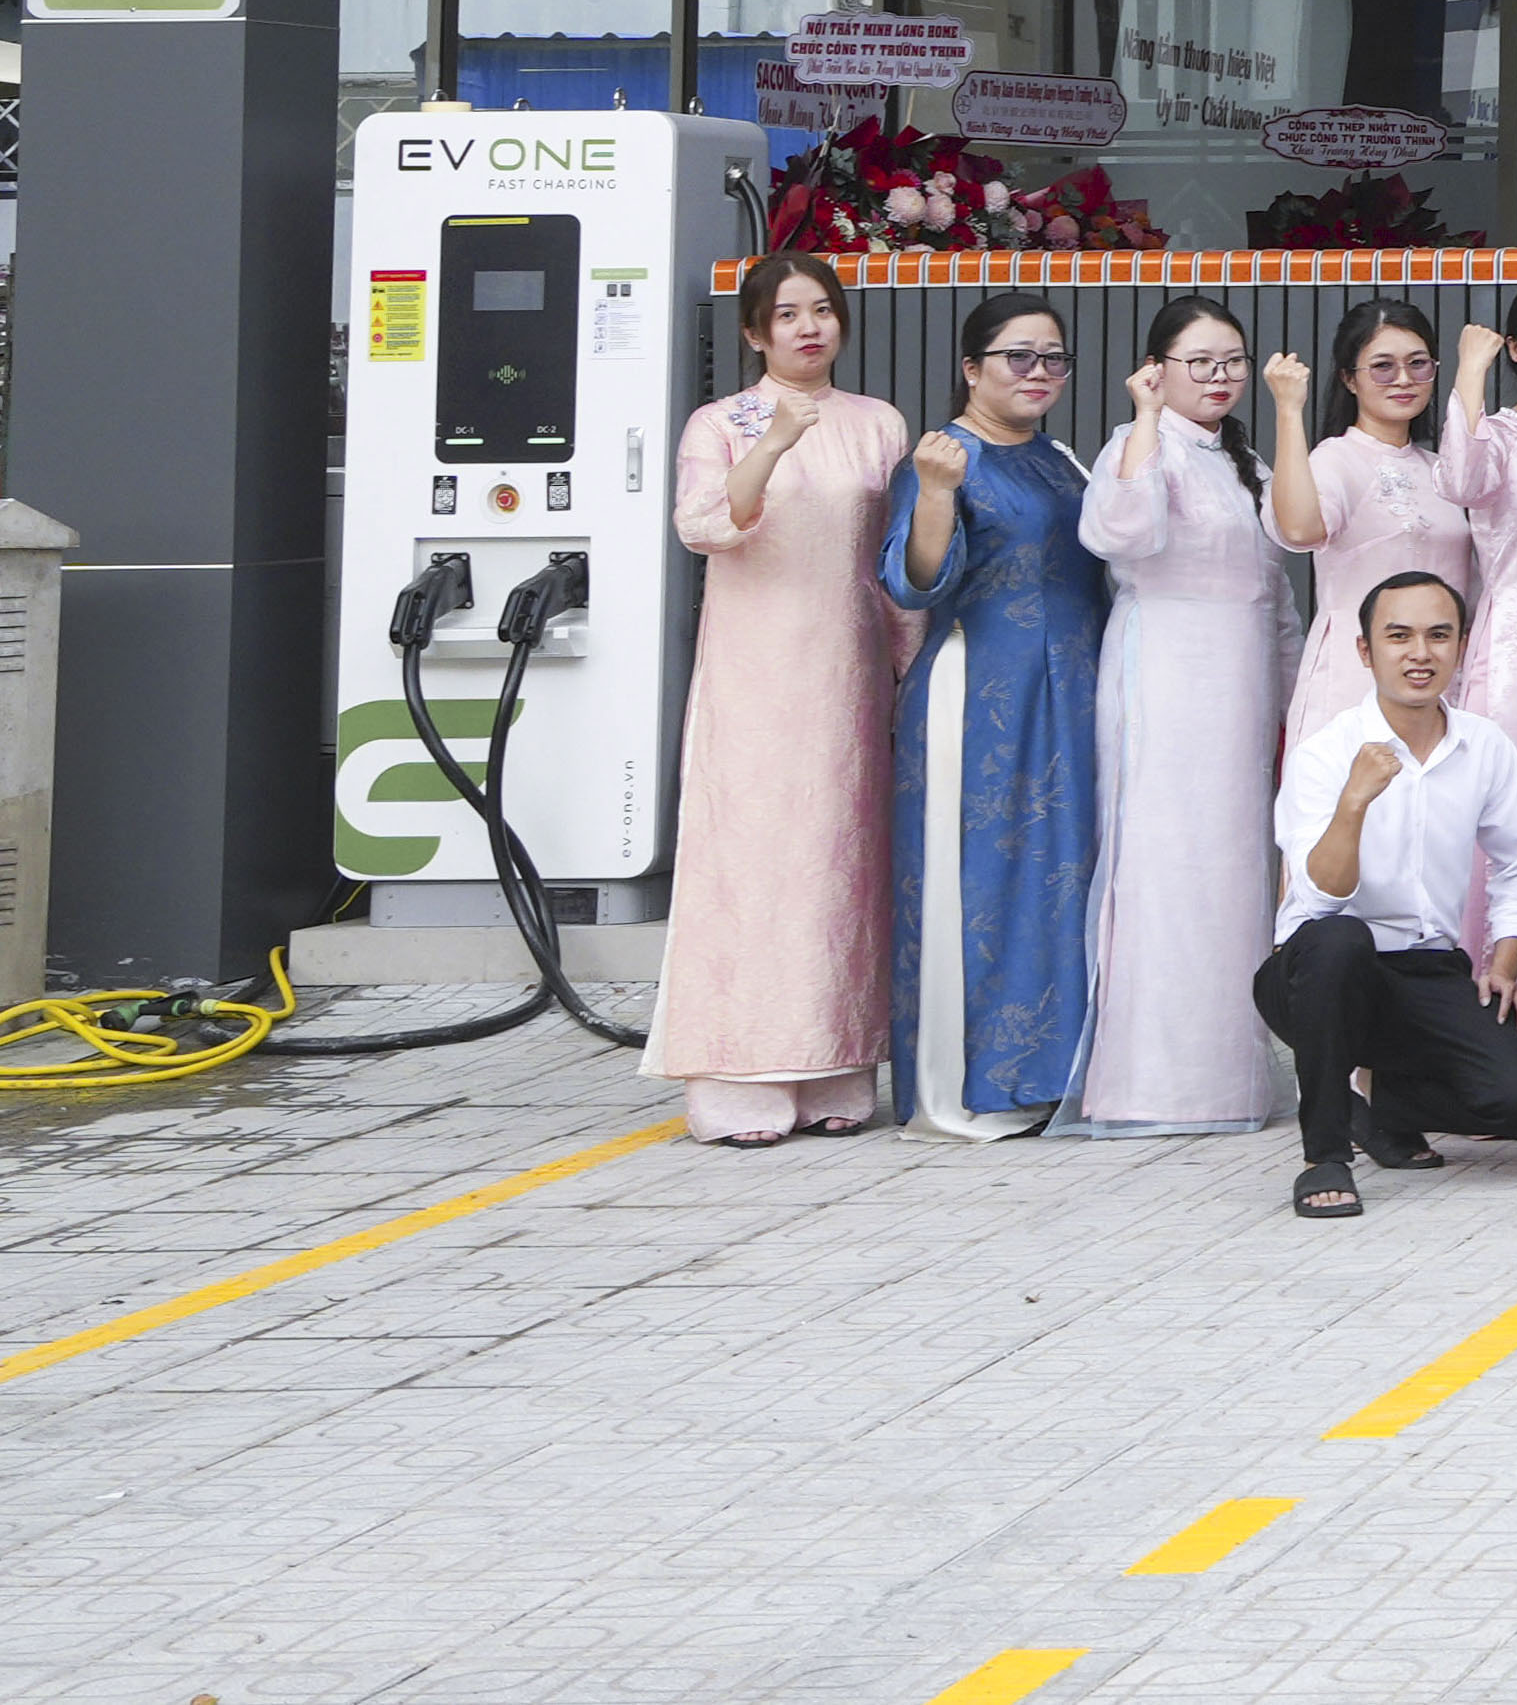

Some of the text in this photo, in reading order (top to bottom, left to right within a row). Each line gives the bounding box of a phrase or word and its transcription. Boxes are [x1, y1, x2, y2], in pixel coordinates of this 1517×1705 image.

[398, 138, 616, 171] EV ONE
[488, 178, 617, 190] FAST CHARGING
[622, 759, 634, 859] ev-one.vn
